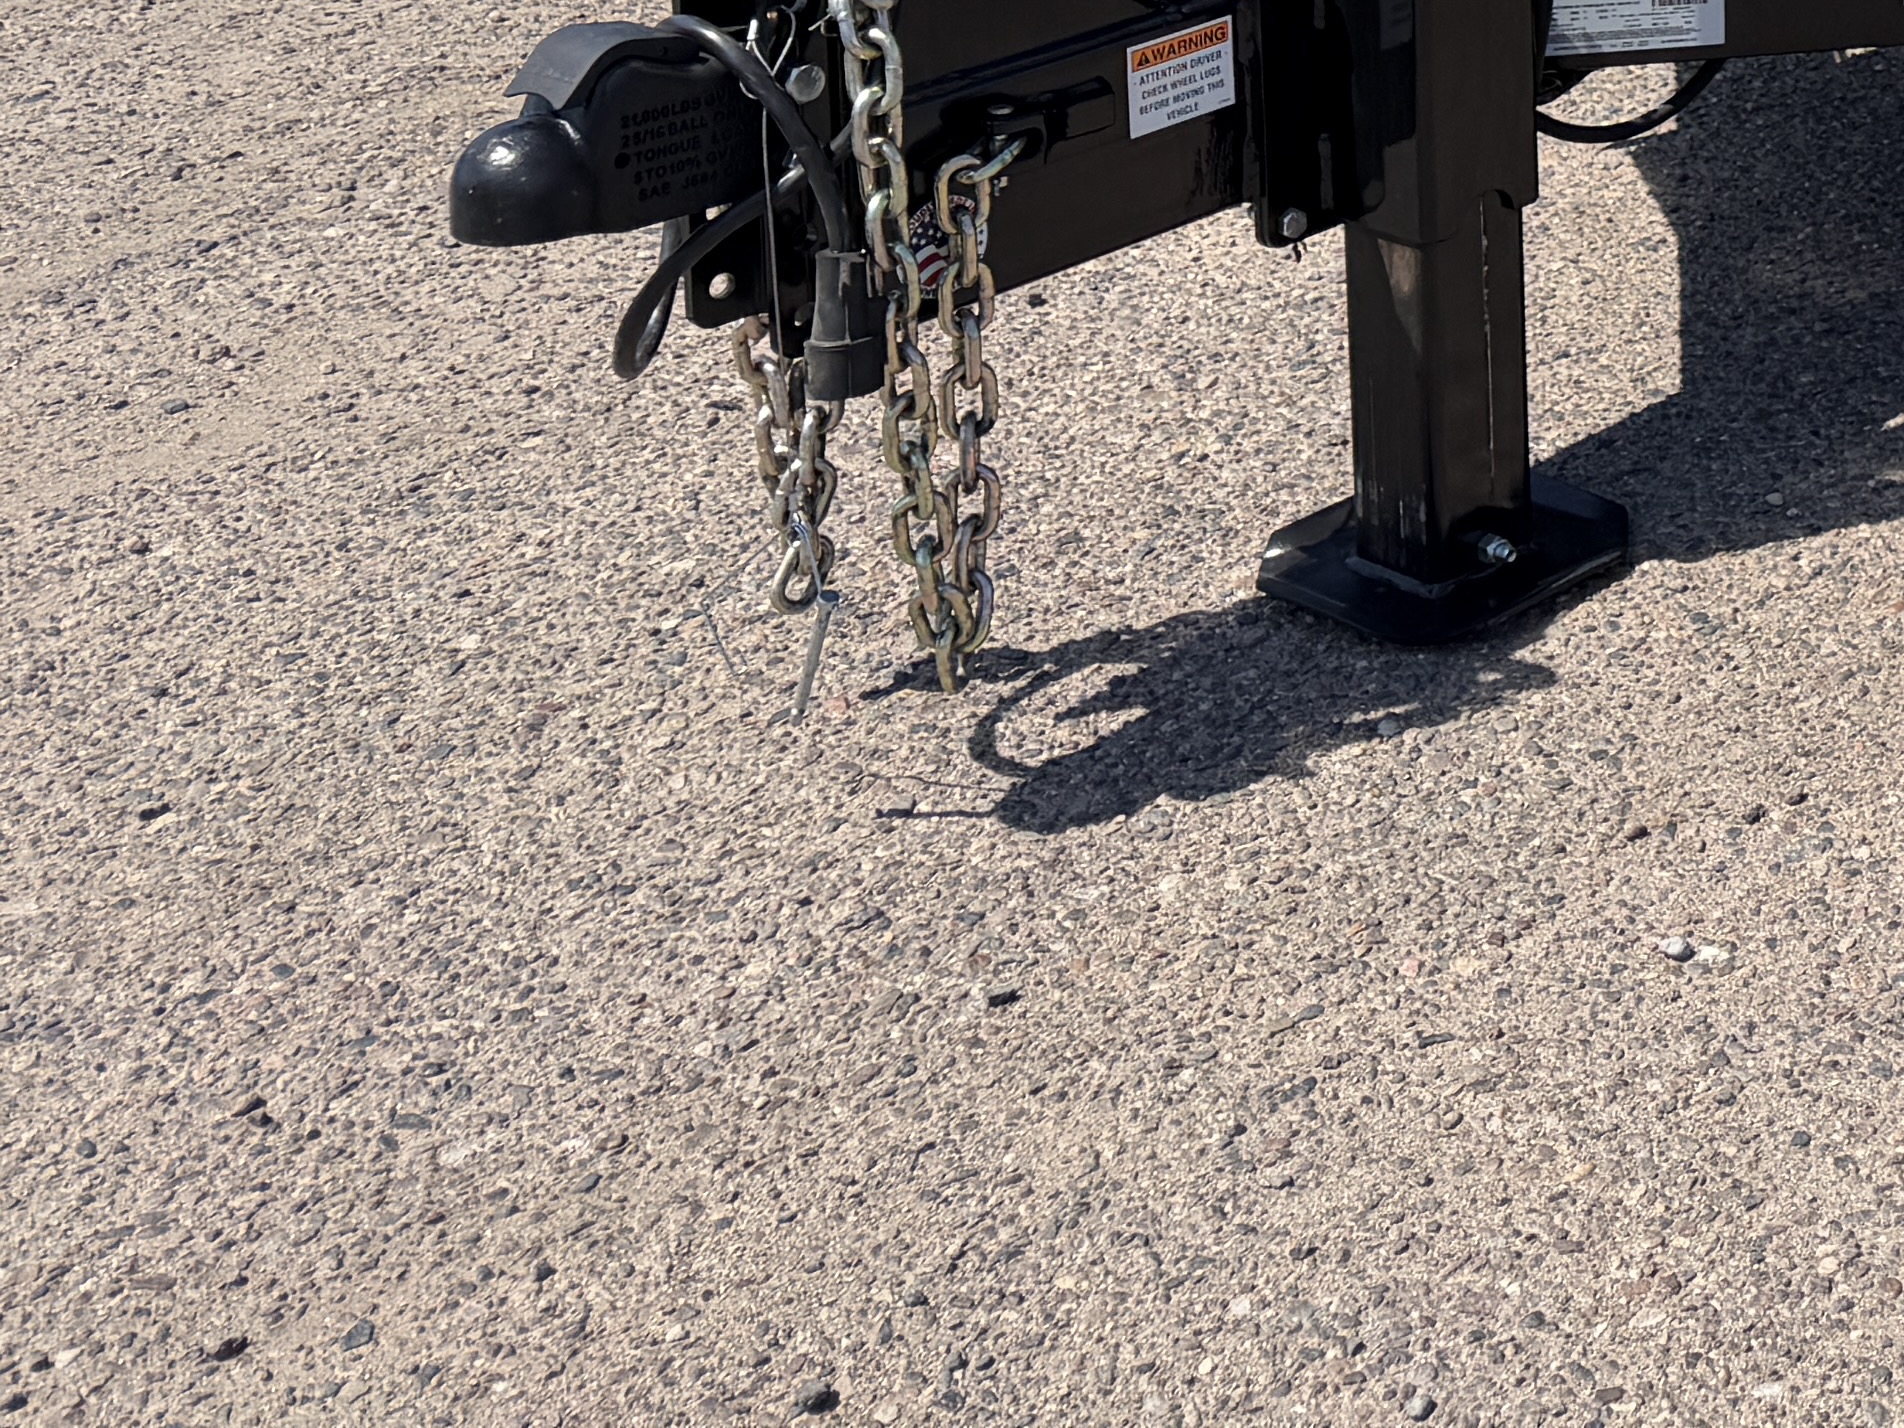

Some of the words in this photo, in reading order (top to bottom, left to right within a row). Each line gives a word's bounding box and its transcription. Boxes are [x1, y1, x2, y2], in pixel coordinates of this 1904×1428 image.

[1151, 26, 1226, 62] WARNING
[1139, 61, 1188, 86] ATTENTION
[1190, 50, 1222, 69] DRIVER
[1142, 83, 1169, 100] CHECK
[1170, 74, 1198, 90] WHEEL
[1200, 65, 1221, 80] LUGS
[1139, 97, 1170, 115] BEFORE
[1172, 85, 1204, 103] MOVING
[1207, 78, 1225, 93] THIS
[1166, 102, 1199, 121] VEHICLE
[633, 135, 702, 165] TONGUE
[638, 181, 671, 202] SAE
